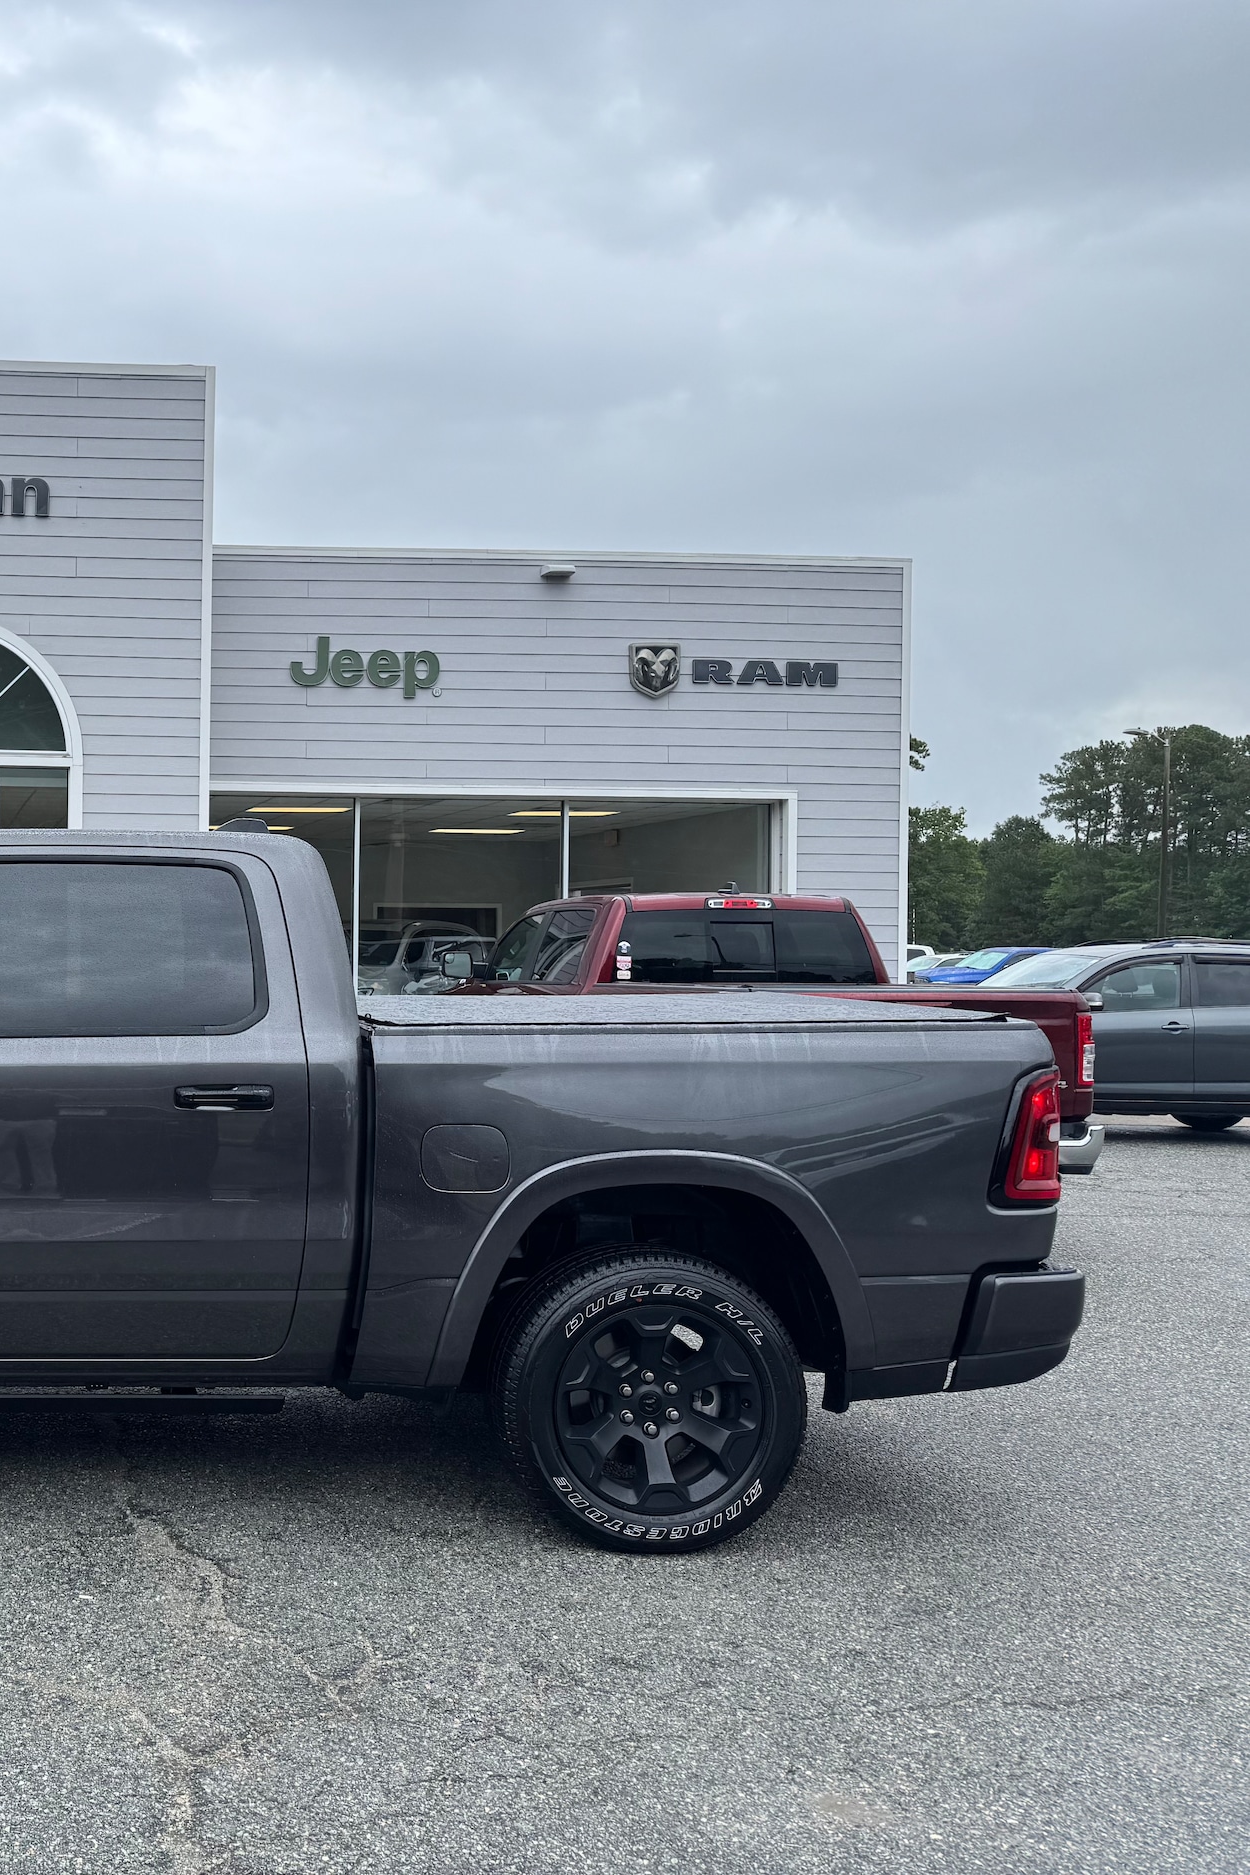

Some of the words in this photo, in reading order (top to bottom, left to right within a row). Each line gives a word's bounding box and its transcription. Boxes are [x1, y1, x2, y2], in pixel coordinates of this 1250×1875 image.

[290, 636, 440, 699] Jeep
[692, 659, 839, 687] RAM
[565, 1283, 704, 1338] DUELER
[715, 1302, 766, 1345] H/L
[553, 1478, 763, 1540] BRIDGESTONE
